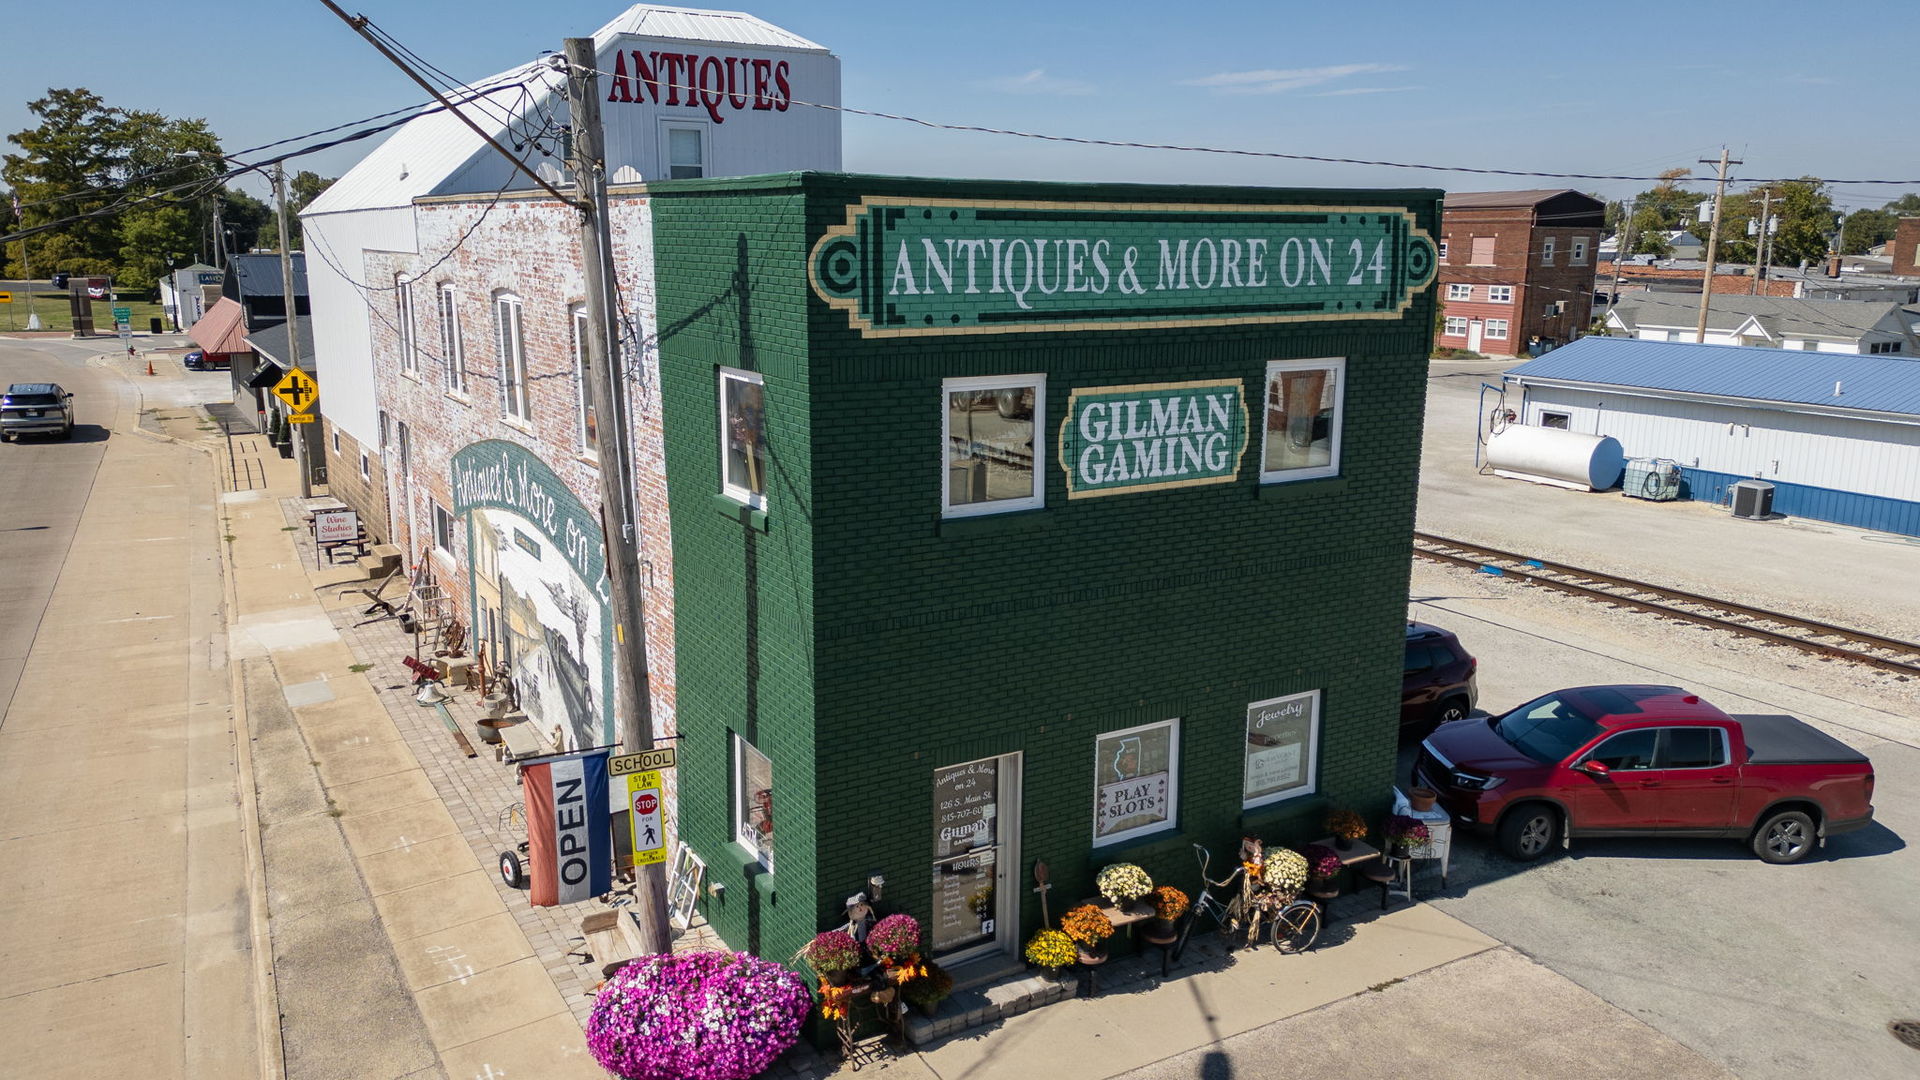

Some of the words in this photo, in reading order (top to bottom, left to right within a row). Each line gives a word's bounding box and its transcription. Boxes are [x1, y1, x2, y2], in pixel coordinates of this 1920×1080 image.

[607, 49, 791, 124] ANTIQUES
[888, 238, 1110, 309] ANTIQUES
[1117, 246, 1148, 294] &
[1155, 237, 1268, 290] MORE
[1280, 237, 1334, 287] ON
[1346, 238, 1387, 286] 24
[1080, 393, 1233, 443] GILMAN
[1079, 432, 1230, 484] GAMING
[326, 516, 348, 524] Wine
[455, 457, 501, 507] Antiques
[502, 451, 516, 507] &
[517, 459, 558, 537] More
[566, 517, 588, 576] on
[321, 525, 352, 533] Slushies
[1256, 702, 1303, 729] Jewelry
[615, 753, 671, 772] SCHOOL
[633, 773, 656, 783] STATE
[637, 781, 652, 789] LAW
[936, 768, 966, 788] Antiques
[967, 764, 975, 774] &
[976, 764, 995, 775] More
[954, 783, 964, 791] on
[966, 778, 976, 788] 24
[940, 800, 953, 810] 126
[964, 795, 981, 804] Main
[1115, 783, 1151, 803] PLAY
[636, 800, 657, 810] STOP
[1109, 796, 1155, 818] SLOTS
[556, 778, 587, 885] OPEN
[952, 858, 980, 871] HOURS
